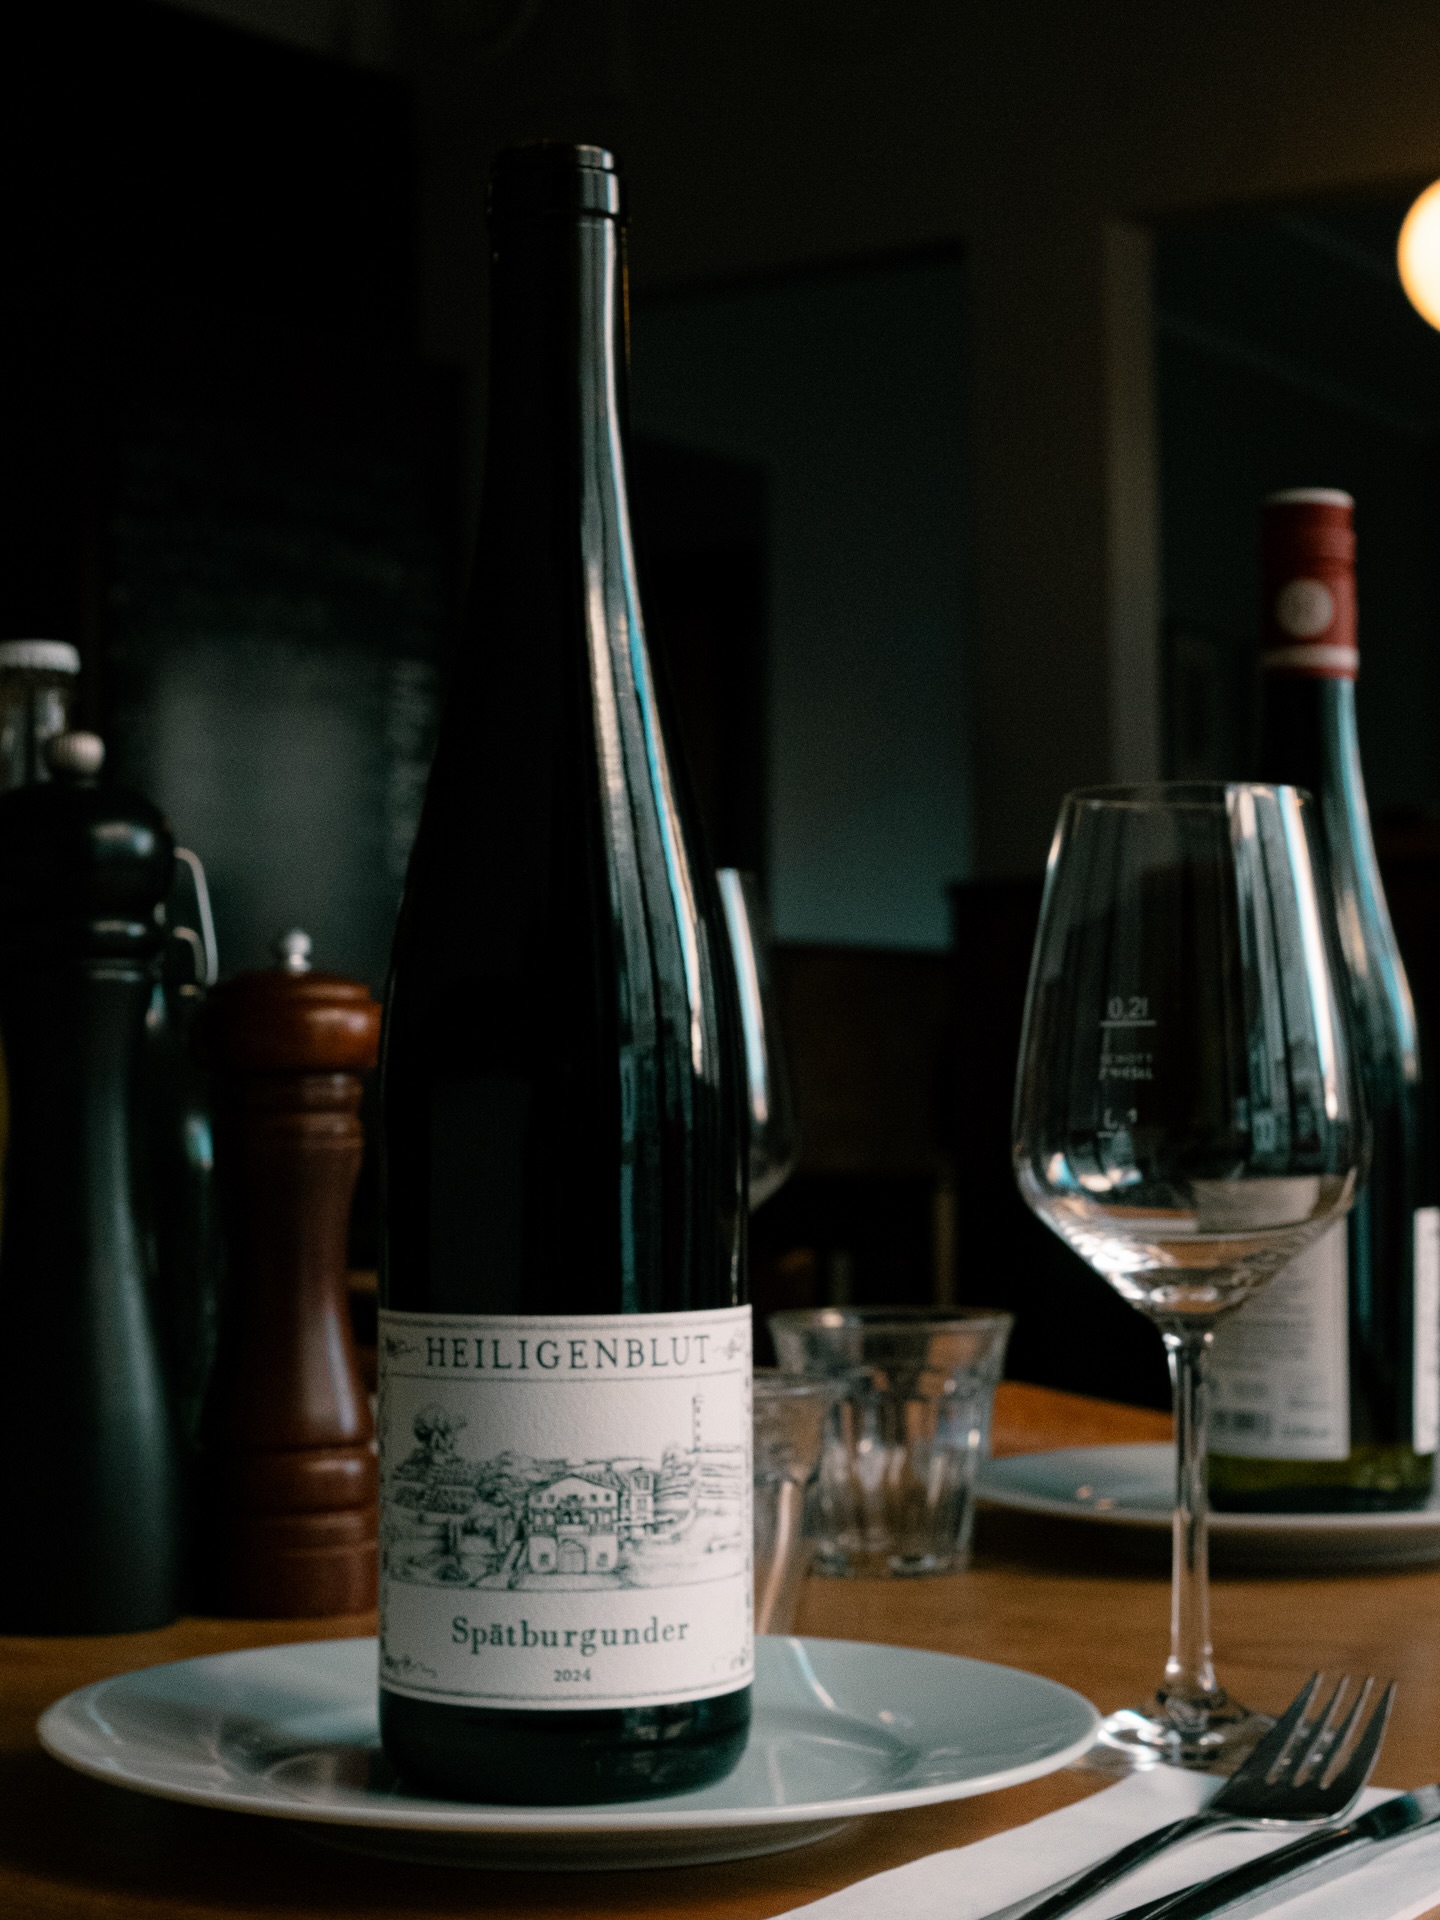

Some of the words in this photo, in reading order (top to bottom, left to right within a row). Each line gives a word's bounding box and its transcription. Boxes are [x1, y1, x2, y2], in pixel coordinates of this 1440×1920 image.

[426, 1335, 710, 1370] HEILIGENBLUT
[451, 1615, 690, 1657] Spätburgunder
[553, 1668, 592, 1683] 2024
